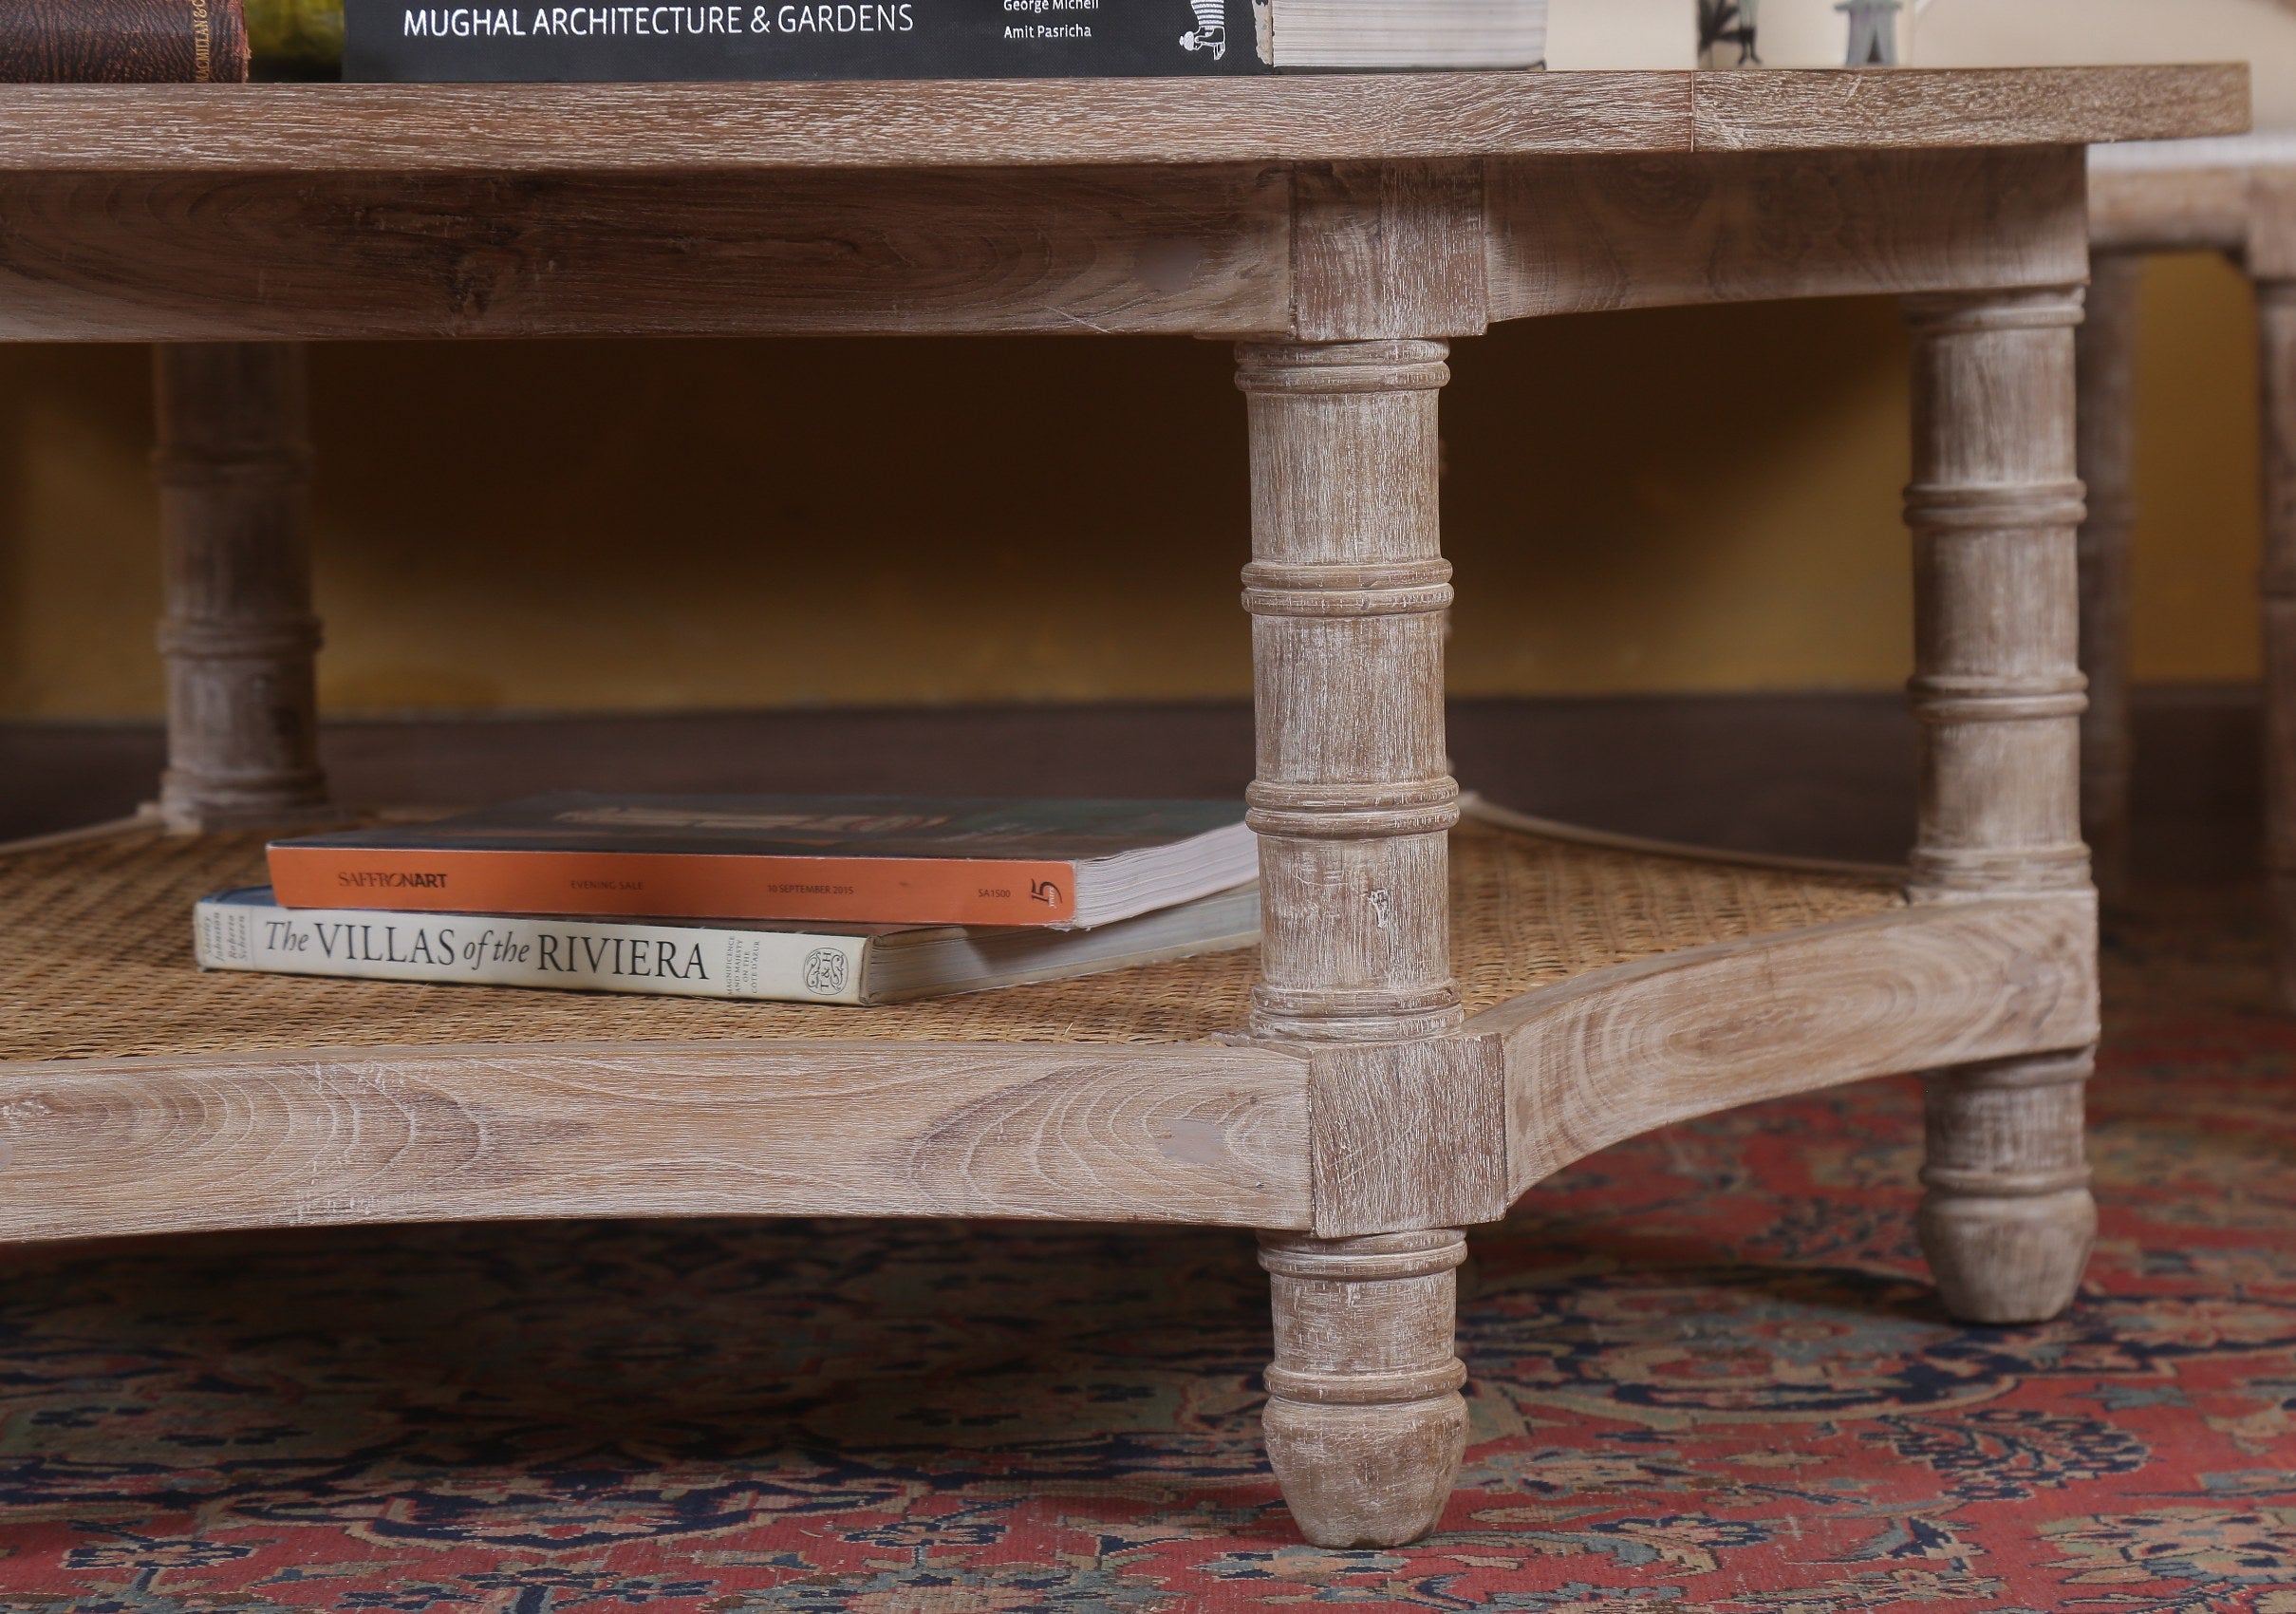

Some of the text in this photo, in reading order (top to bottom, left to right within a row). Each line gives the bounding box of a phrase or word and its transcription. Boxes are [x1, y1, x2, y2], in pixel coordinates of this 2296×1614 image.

[193, 7, 208, 18] &
[1003, 0, 1099, 13] George Michell
[403, 4, 914, 37] MUGHAL ARCHITECTURE & GARDENS
[1003, 23, 1092, 39] Amit Pasricha
[338, 872, 447, 889] SAFFRONART
[570, 879, 644, 891] EVENING SALE
[767, 883, 855, 895] 10 SEPTEMBER 2015
[978, 889, 1012, 898] SA1500
[266, 920, 710, 980] The VILLAS of the RIVIERA
[725, 936, 736, 996] MAGNIFICENCE
